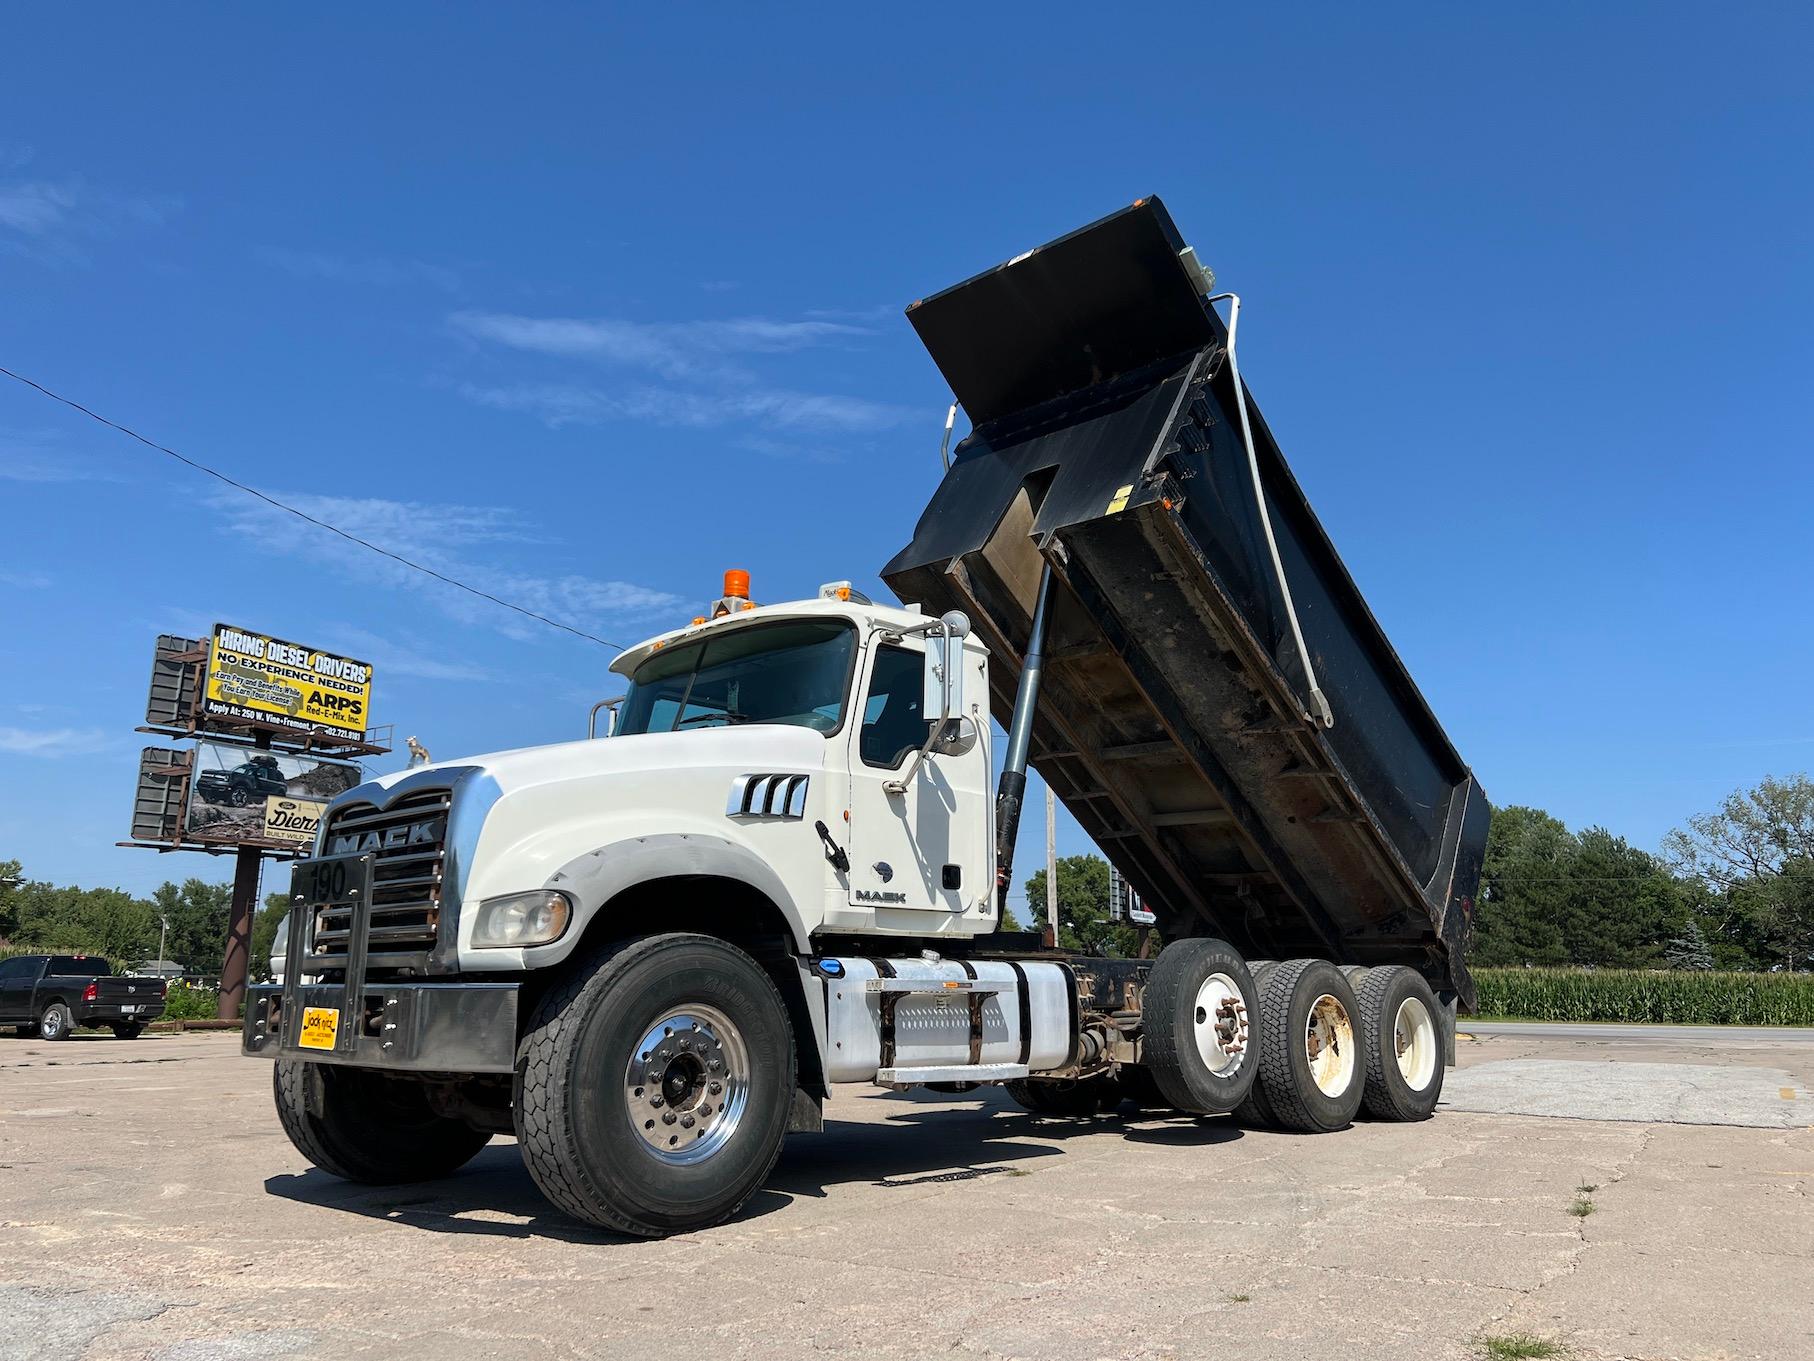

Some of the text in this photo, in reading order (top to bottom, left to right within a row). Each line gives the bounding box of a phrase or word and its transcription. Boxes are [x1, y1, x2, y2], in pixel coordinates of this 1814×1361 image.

[219, 628, 366, 684] HIRING DIESEL DRIVERS
[215, 670, 300, 697] Earn Pay and Benefits While
[217, 651, 363, 696] NO EXPERIENCE NEEDED!
[223, 683, 235, 692] You
[235, 686, 251, 696] Earn
[251, 690, 266, 699] Your
[307, 690, 362, 715] ARPS
[209, 702, 230, 716] Apply
[230, 706, 241, 716] At:
[241, 708, 255, 720] 250
[256, 711, 264, 721] W.
[306, 705, 361, 725] Red-E-Mix, Inc.
[266, 830, 285, 838] BUILT
[333, 821, 436, 852] MACK
[310, 861, 346, 901] 190
[855, 889, 906, 904] MACK
